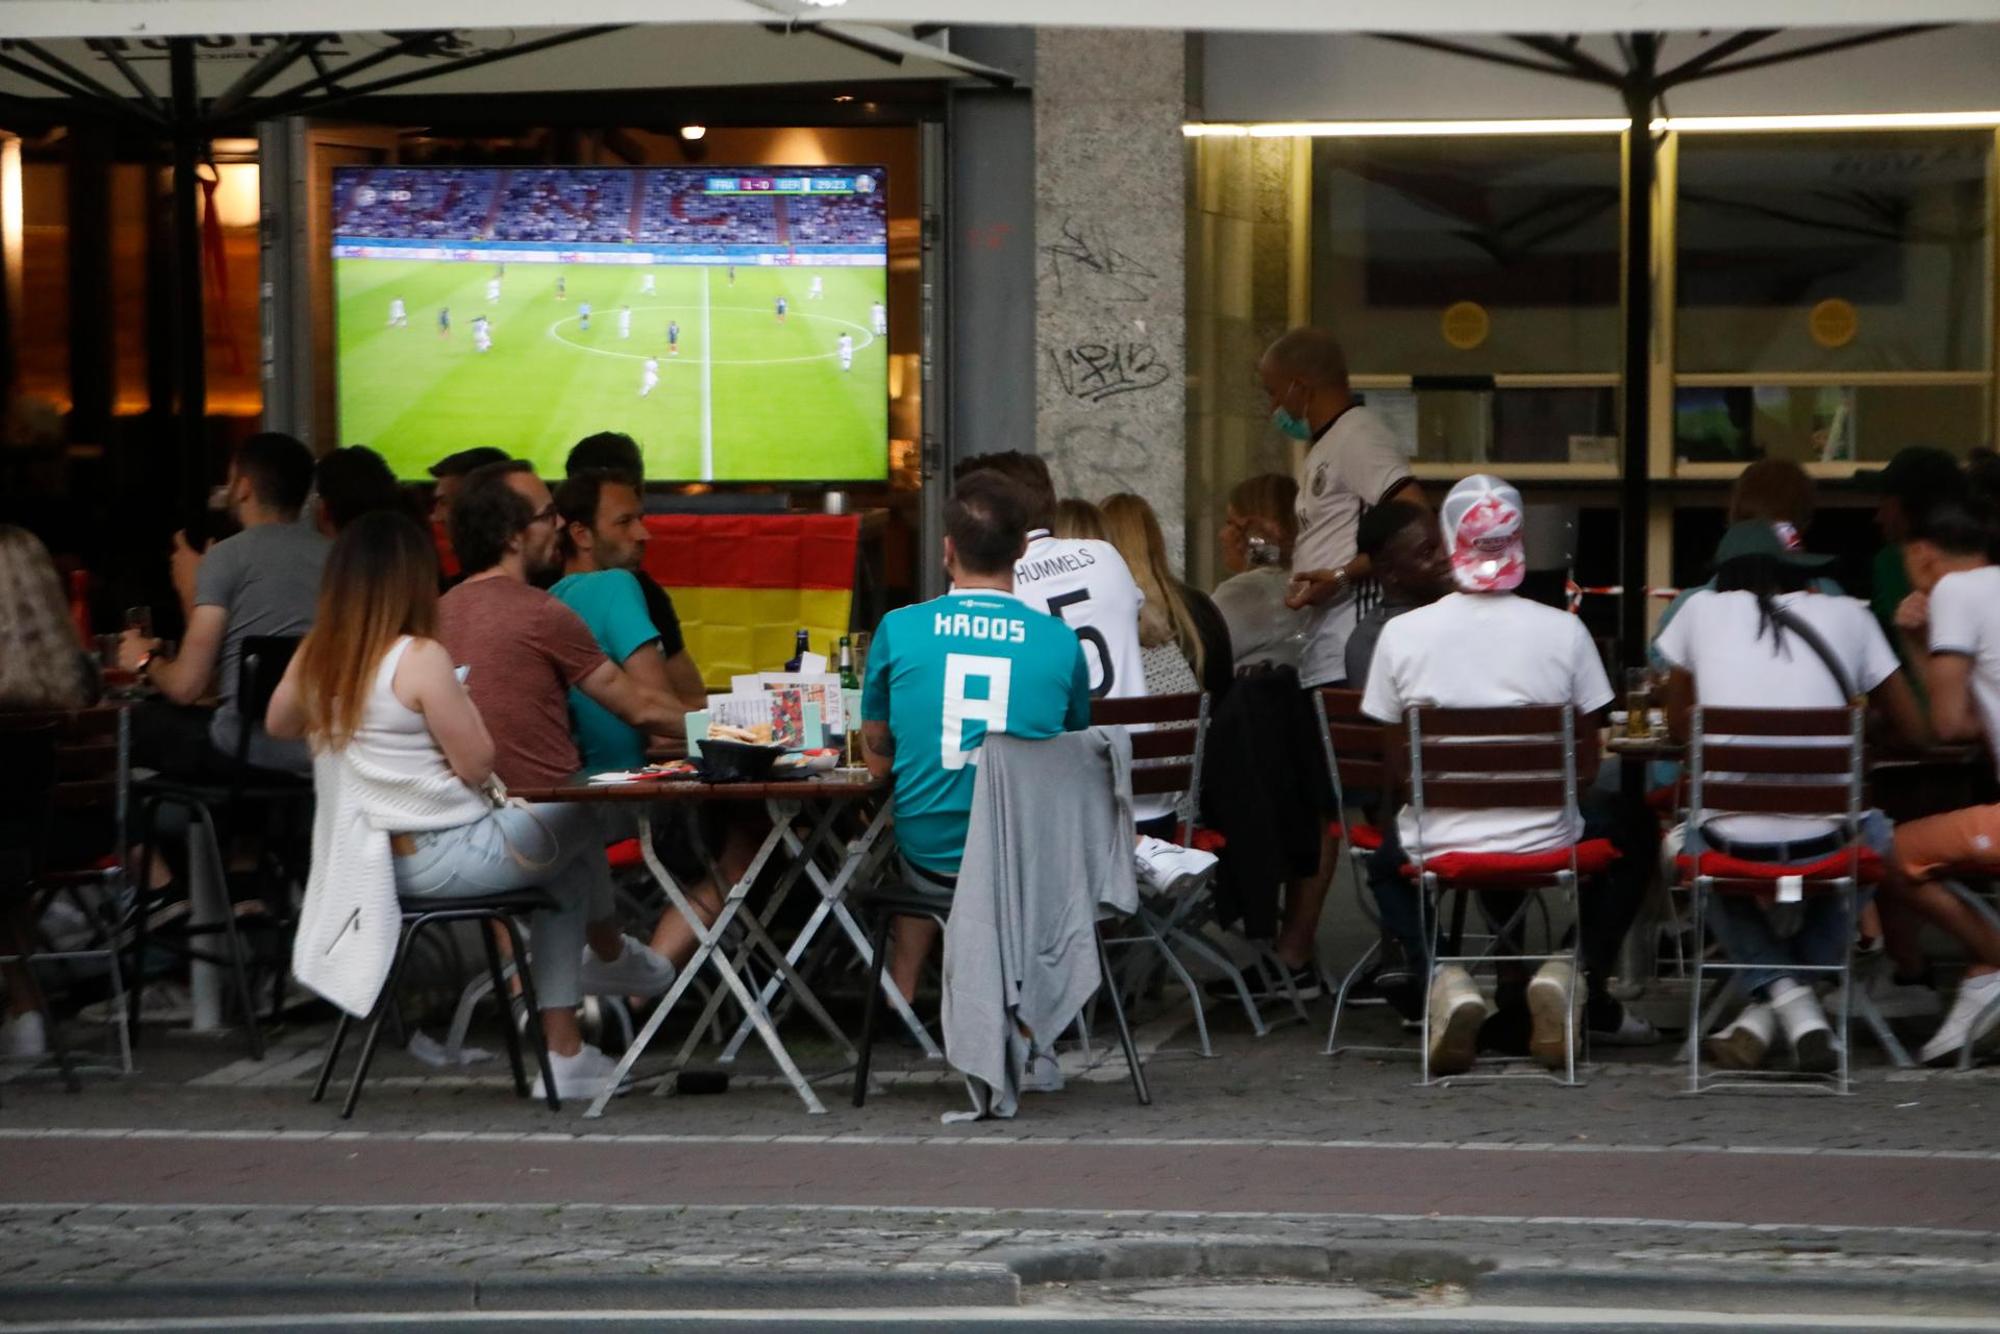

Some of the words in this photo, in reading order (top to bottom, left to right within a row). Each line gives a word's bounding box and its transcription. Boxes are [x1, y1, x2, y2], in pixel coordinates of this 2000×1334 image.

[743, 180, 770, 190] 1-0
[1015, 547, 1097, 585] HUMMELS
[934, 612, 1026, 643] KROOS
[1046, 587, 1115, 698] 5
[941, 652, 1013, 771] 8
